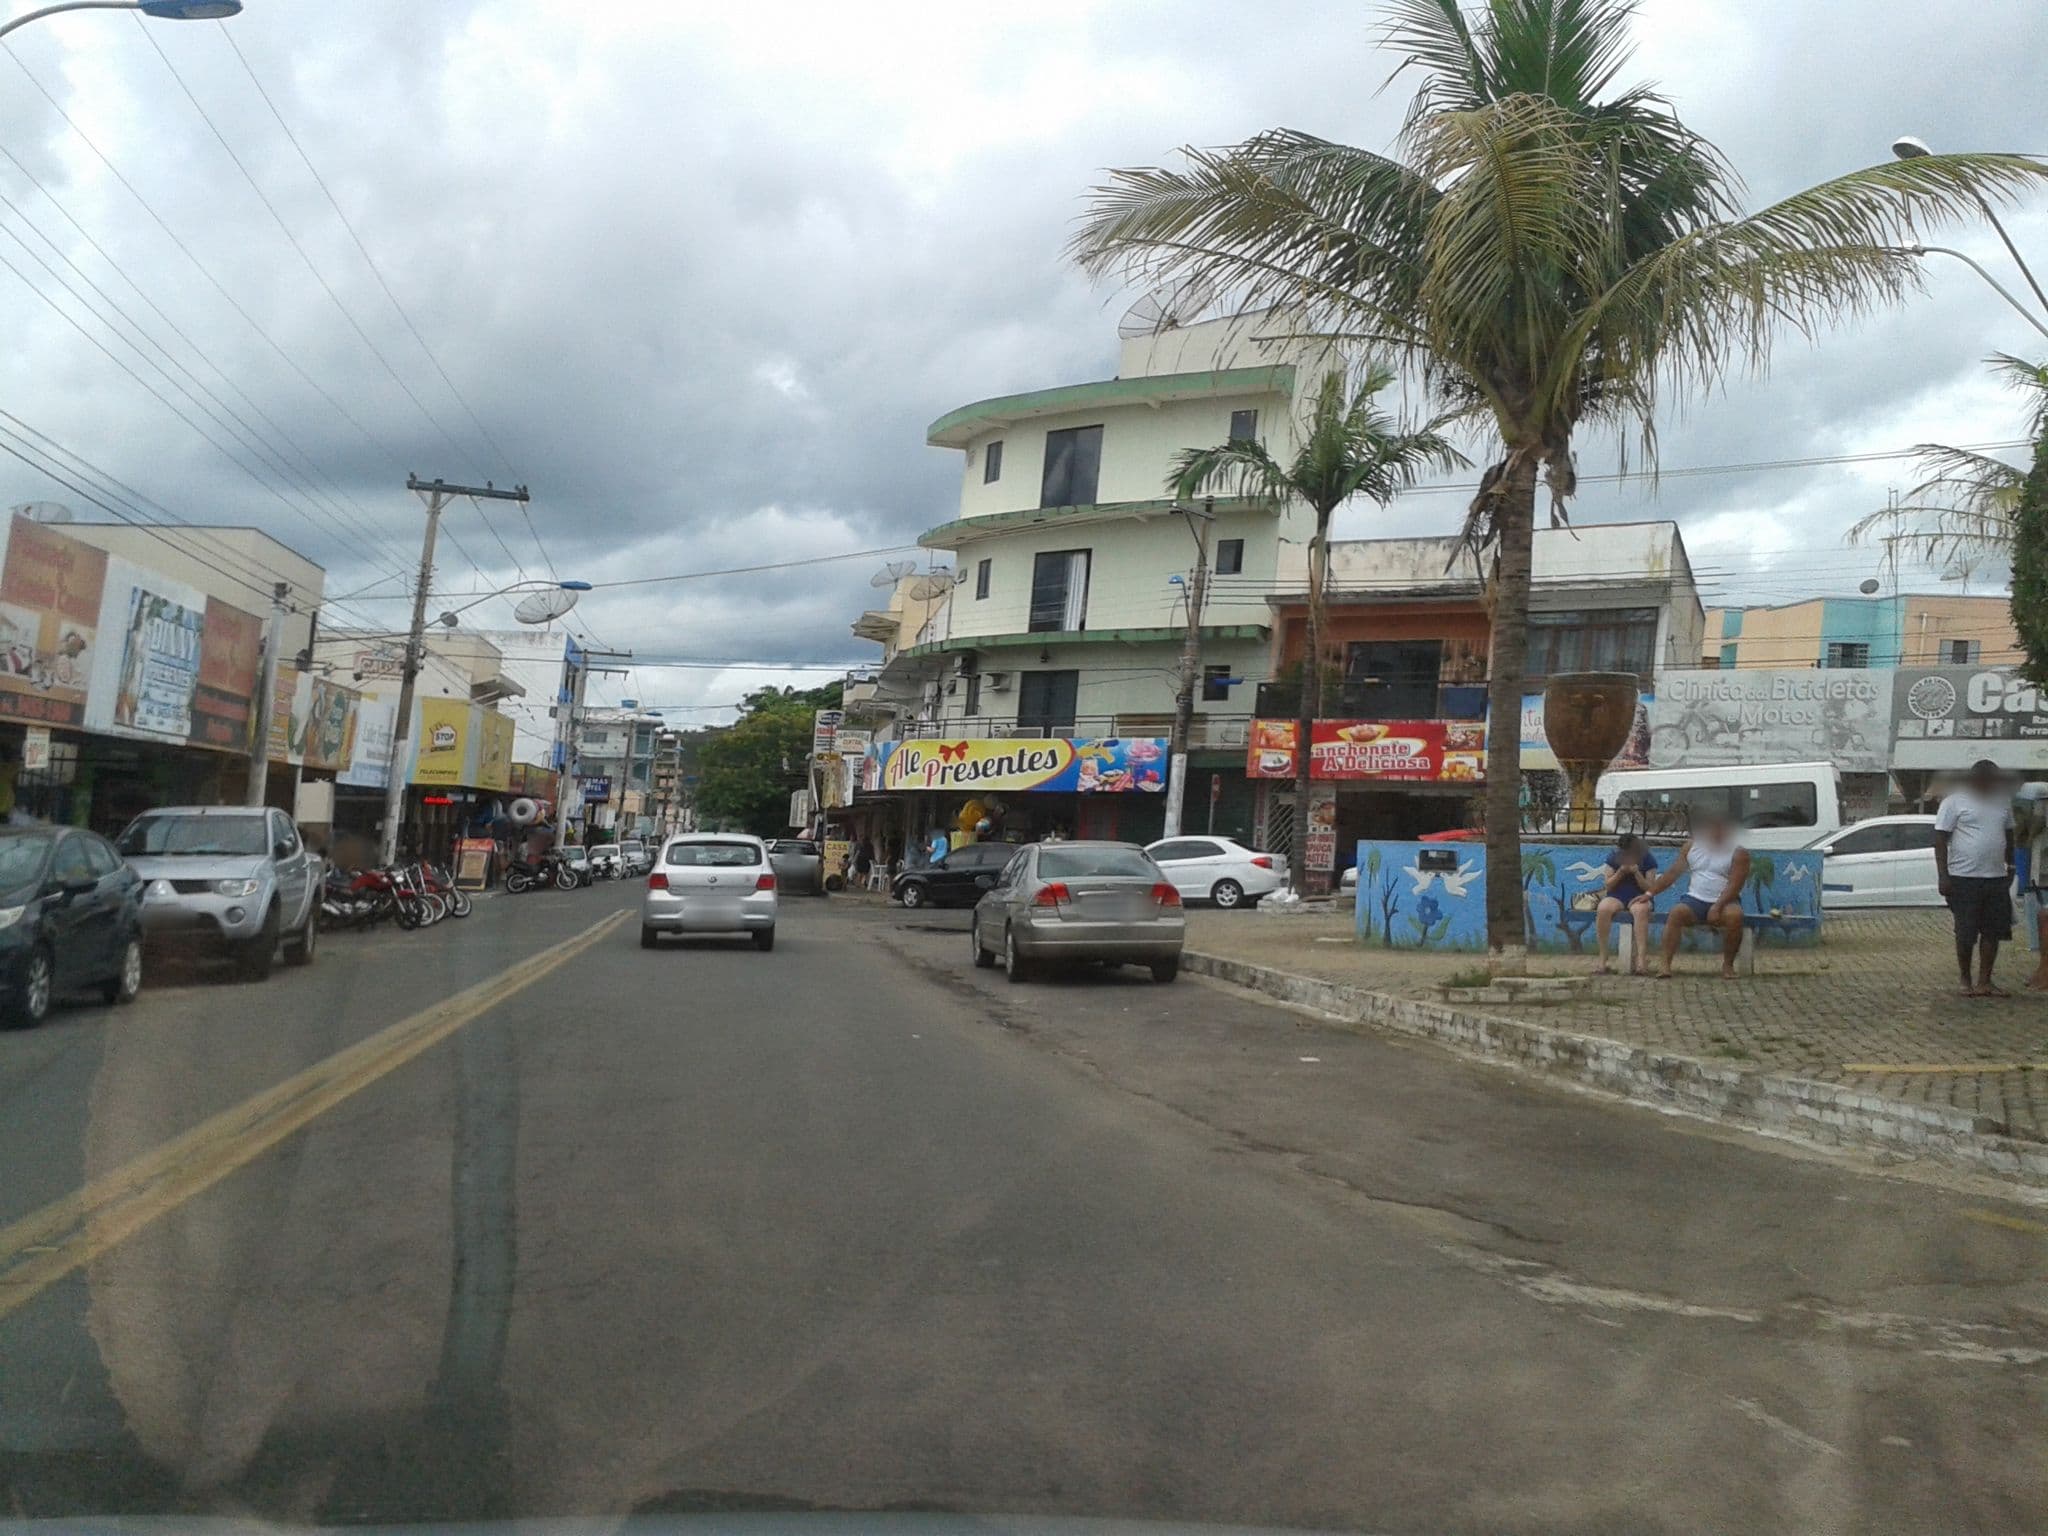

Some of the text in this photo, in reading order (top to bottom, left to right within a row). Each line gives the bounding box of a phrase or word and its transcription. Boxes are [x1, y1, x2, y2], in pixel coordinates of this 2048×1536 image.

[1770, 675, 1880, 701] Bicicletas
[1968, 672, 2048, 713] Ca
[1738, 702, 1816, 726] Motos
[1311, 740, 1410, 757] anchonete
[891, 749, 920, 787] Ale
[922, 748, 1058, 787] Presentes
[1323, 756, 1431, 772] A Deliciosa
